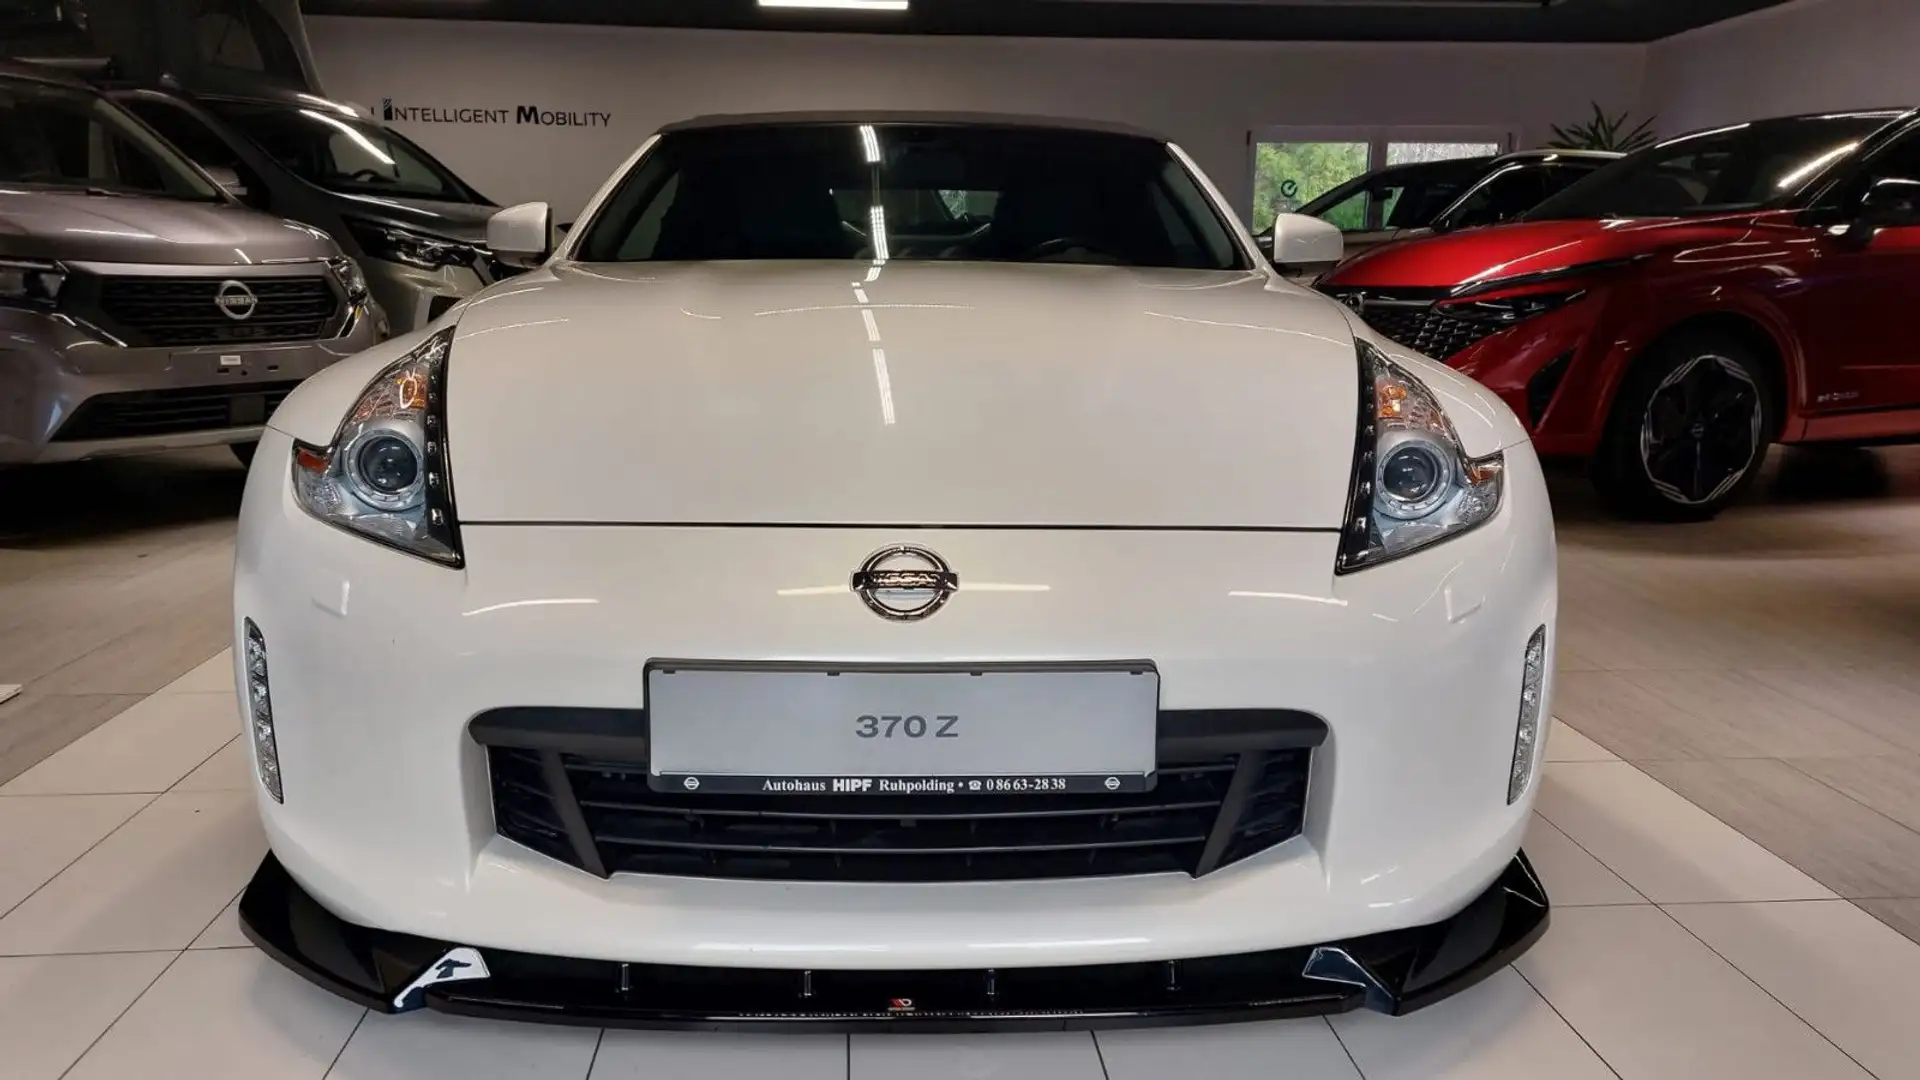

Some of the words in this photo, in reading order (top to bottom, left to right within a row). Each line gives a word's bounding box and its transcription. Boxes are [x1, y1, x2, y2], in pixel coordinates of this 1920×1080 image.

[516, 105, 611, 127] MOBILITY
[856, 715, 927, 738] 370
[935, 715, 959, 738] Z
[762, 779, 826, 791] Autohaus
[832, 778, 872, 792] HIPF
[879, 779, 955, 794] Ruhpolding
